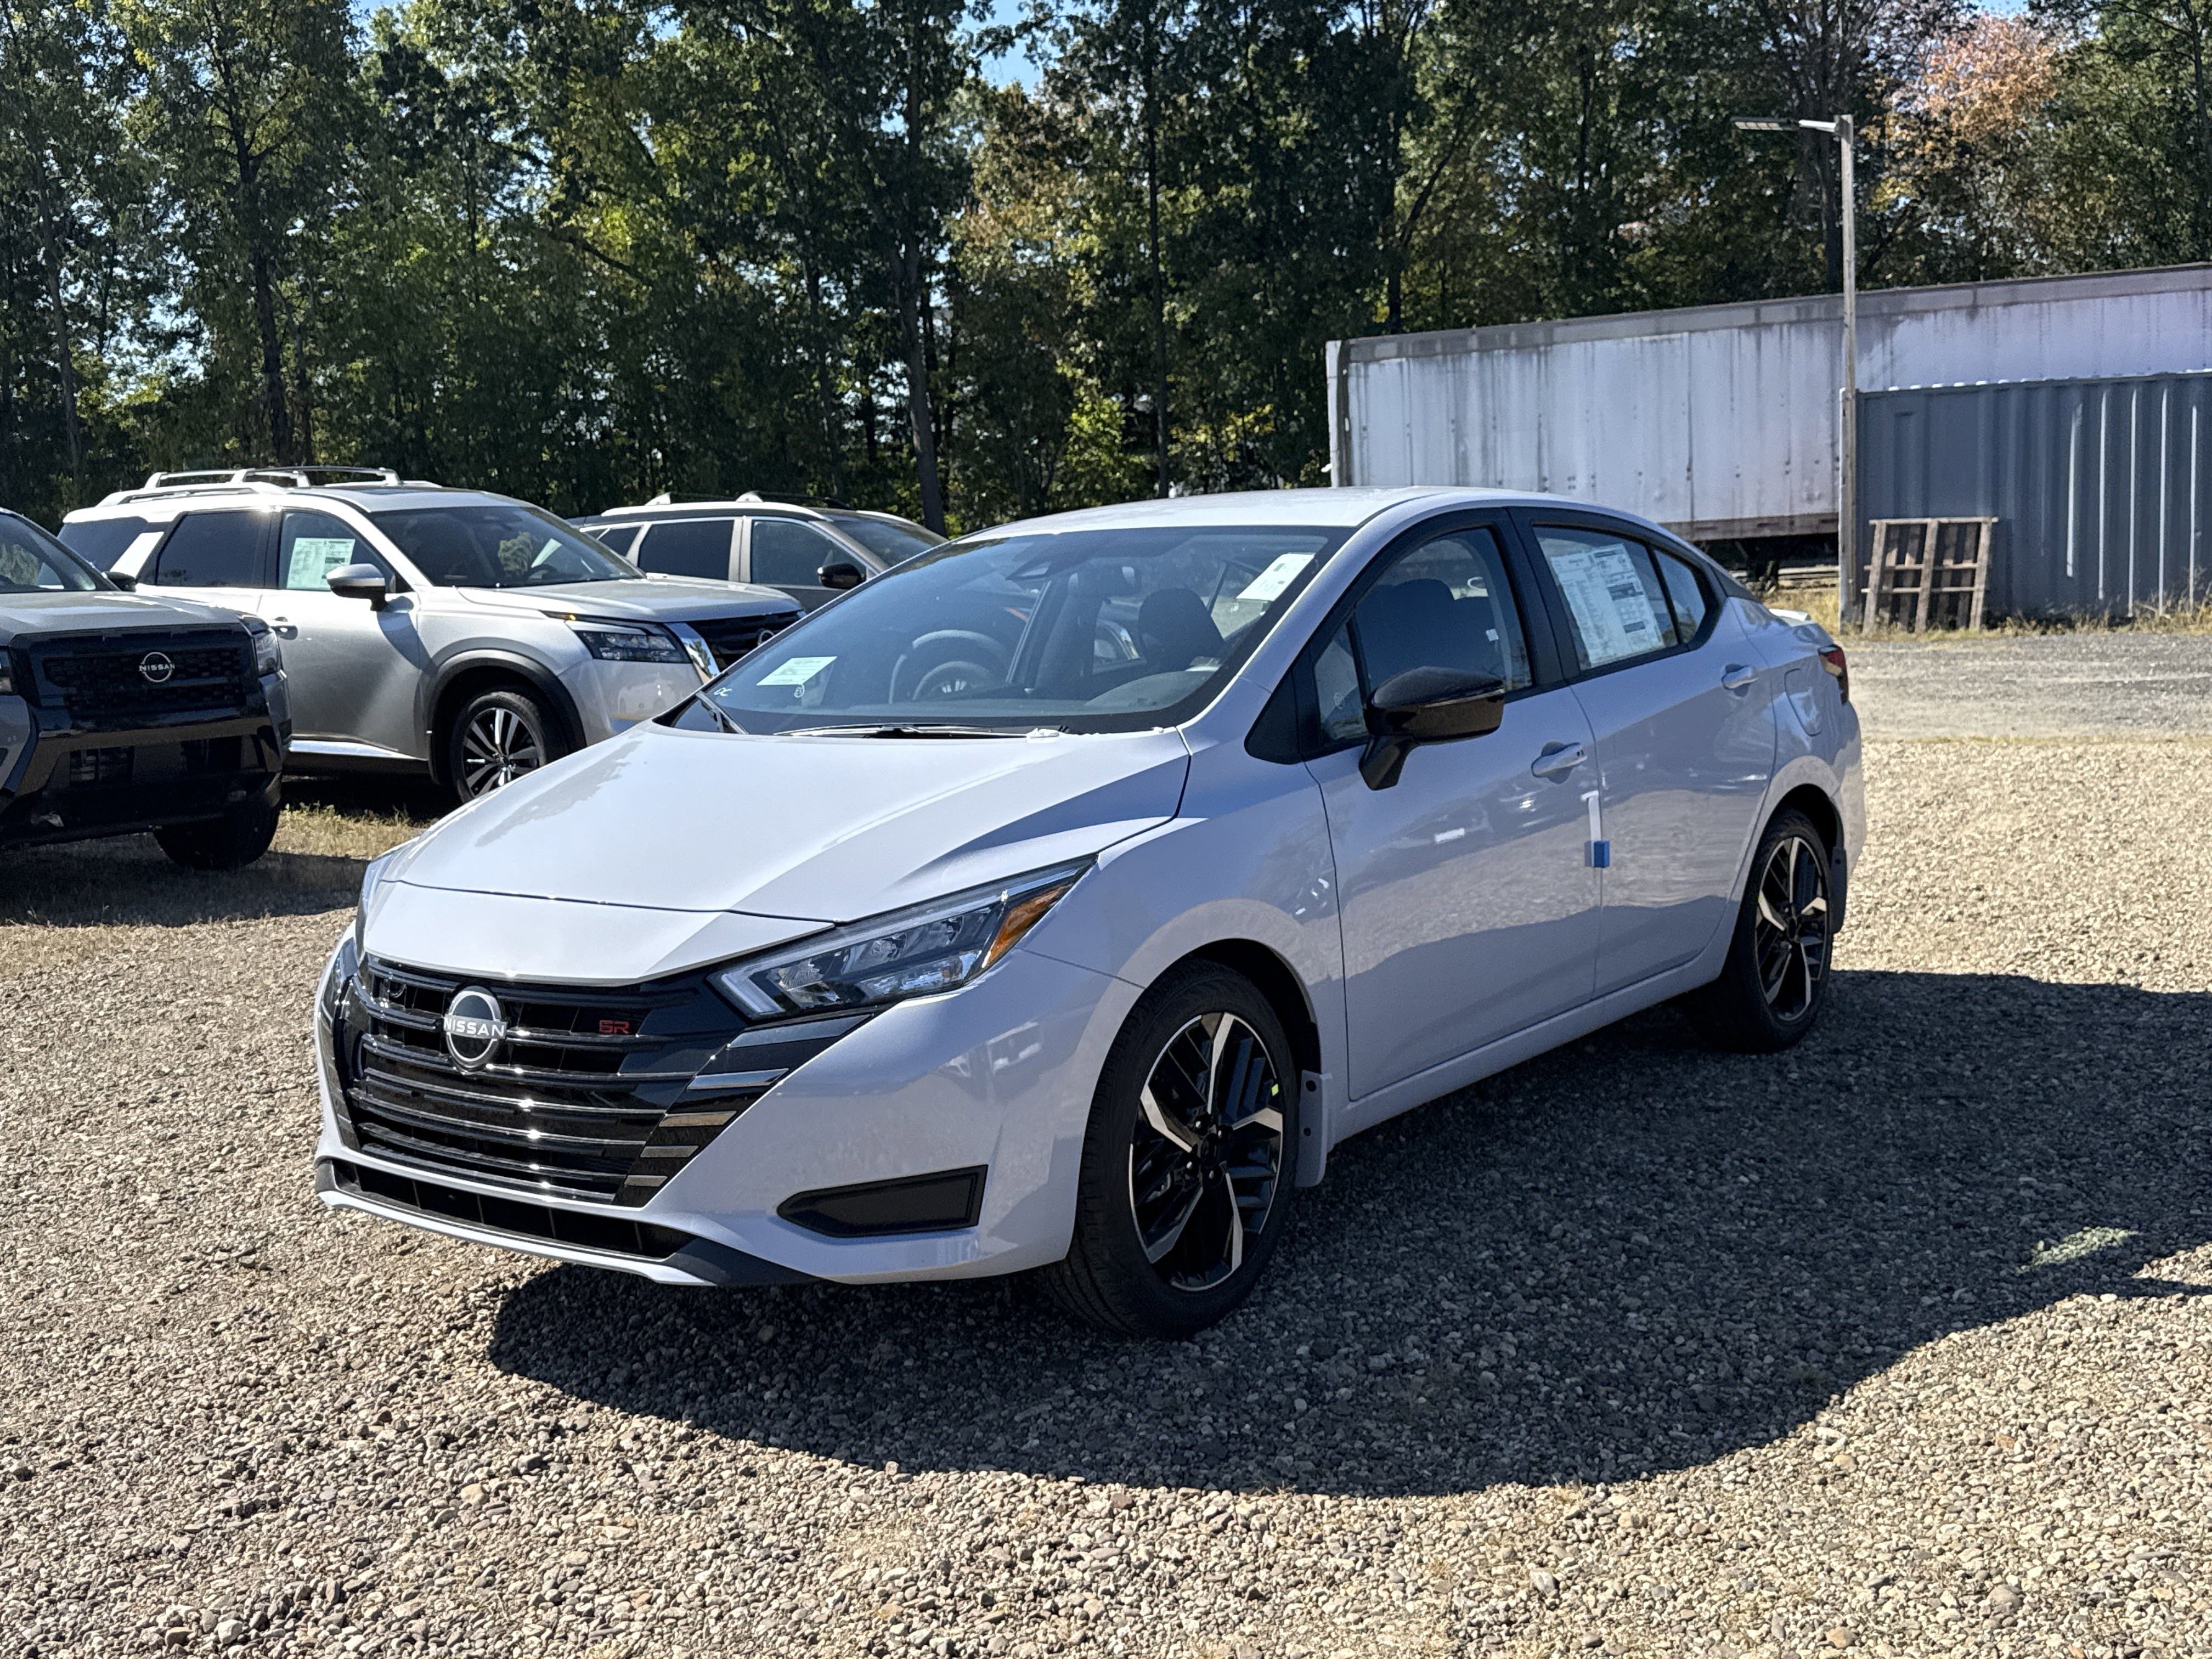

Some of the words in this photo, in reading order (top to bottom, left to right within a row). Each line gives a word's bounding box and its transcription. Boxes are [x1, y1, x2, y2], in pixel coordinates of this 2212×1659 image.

[139, 663, 176, 672] NISSAN
[443, 1017, 505, 1037] NISSAN
[599, 1020, 629, 1034] SR
